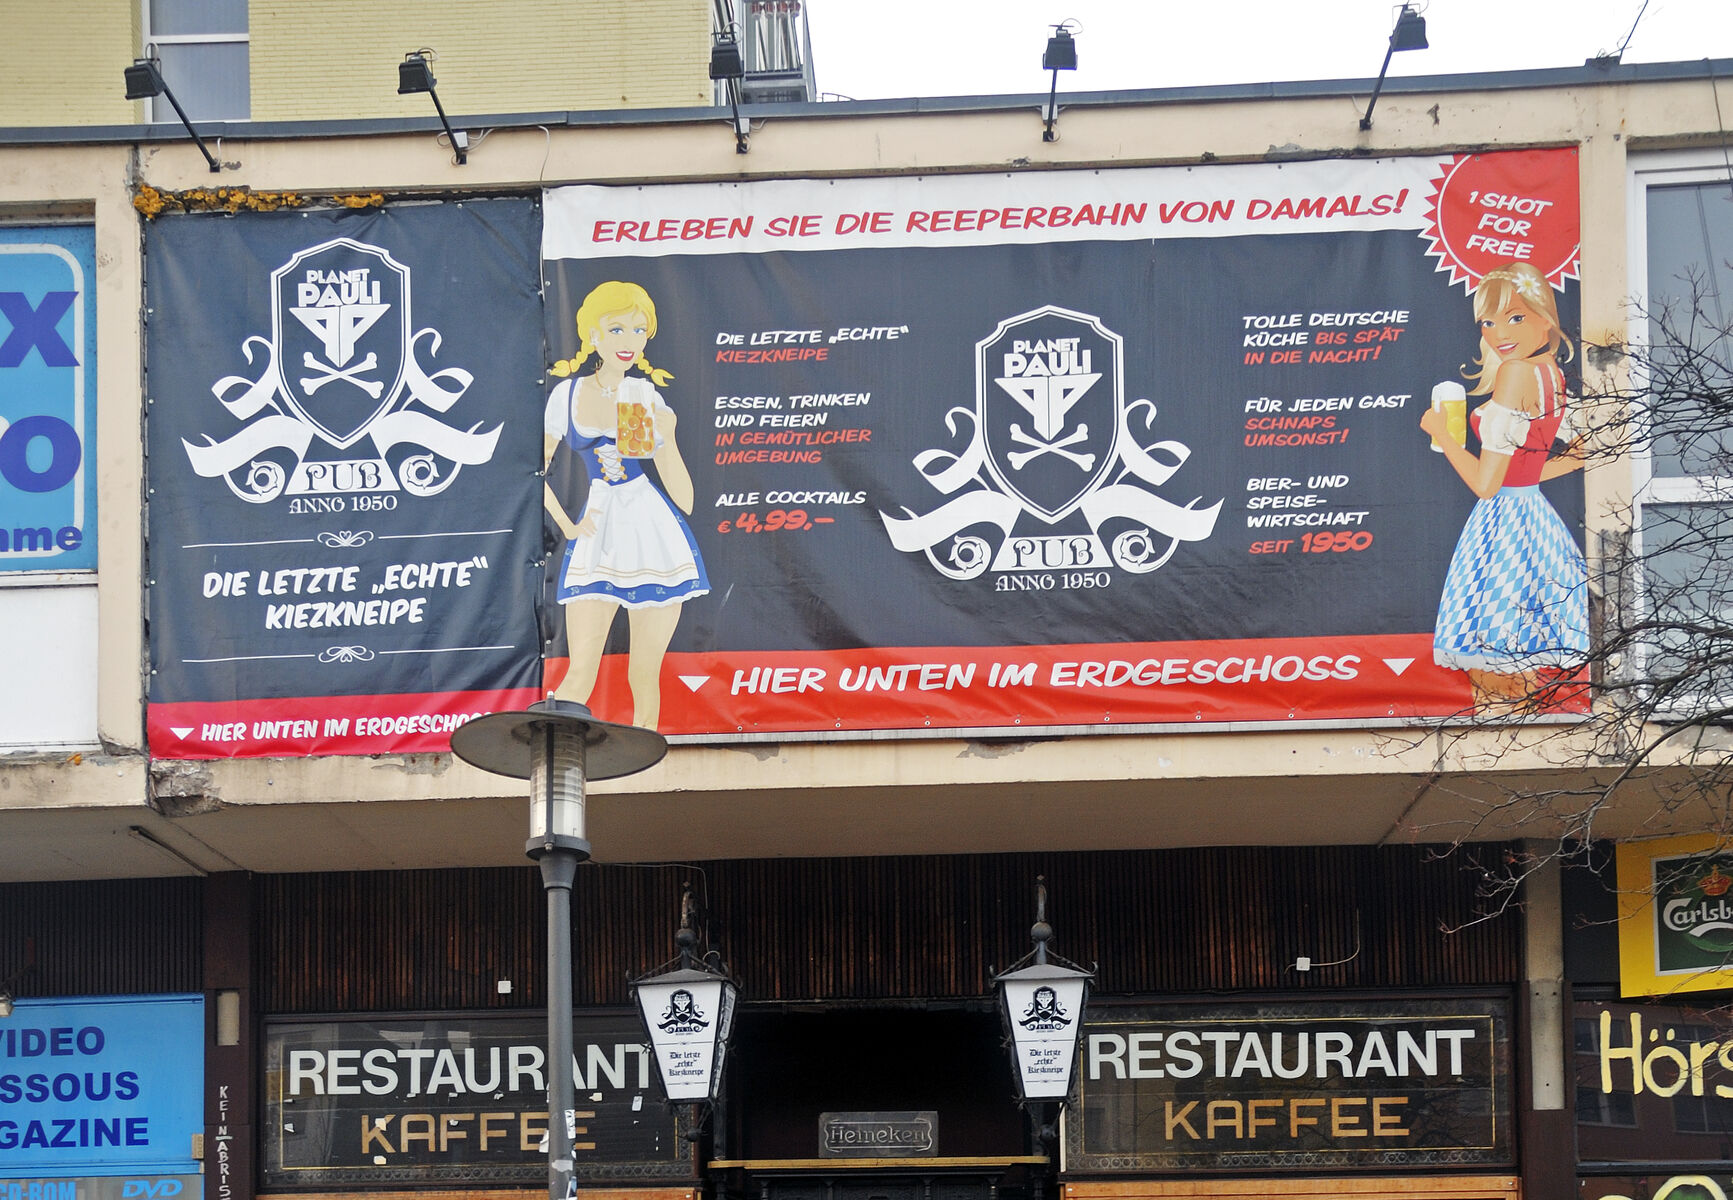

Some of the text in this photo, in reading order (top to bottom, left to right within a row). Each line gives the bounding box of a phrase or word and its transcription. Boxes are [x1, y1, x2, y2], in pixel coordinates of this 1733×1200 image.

[1480, 192, 1554, 217] SHOT
[591, 188, 1410, 243] ERLEBEN SIE DIE REEPERBAHN VON DAMALS!
[1477, 214, 1533, 238] FOR
[1465, 235, 1535, 261] FREE
[306, 268, 370, 285] PLANET
[298, 281, 380, 307] PAULI
[1243, 310, 1410, 329] TOLLE DEUTSCHE
[750, 330, 823, 346] LETZTE
[1013, 337, 1081, 355] PLANET
[1243, 326, 1405, 347] KÜCHE BIS SPÄT
[715, 348, 829, 364] KIEZKNEIPE
[1004, 350, 1092, 378] PAULI
[1244, 346, 1382, 365] IN DIE NACHT!
[789, 393, 871, 409] TRINKEN
[1245, 394, 1412, 413] FÜR JEDEN GAST
[715, 412, 828, 428] UND FEIERN
[1244, 415, 1337, 430] SCHNAPS
[715, 429, 872, 447] IN GEMÜTLICHER
[1244, 428, 1350, 447] UMSONST!
[715, 450, 822, 465] UMGEBUNG
[304, 461, 382, 491] PUB
[1246, 475, 1350, 491] BIER- UND
[289, 495, 398, 514] ANNO 1950
[715, 491, 867, 507] ALLE COCKTAILS
[1246, 494, 1327, 509] SPEISE-
[717, 520, 732, 534] €
[1246, 511, 1370, 528] WIRTSCHAFT
[1249, 530, 1374, 554] SEIT 1950
[1011, 539, 1095, 568] PUB
[203, 571, 248, 598] DIE
[257, 565, 361, 597] LETZTE
[995, 572, 1111, 592] ANNO 1950
[265, 597, 428, 630] KIEZKNEIPE
[730, 654, 1362, 696] HIER UNTEN IM ERDGESCHOSS
[201, 721, 246, 741] HIER
[253, 718, 320, 740] UNTEN
[323, 718, 349, 737] IM
[0, 1026, 106, 1058] IDEO
[1088, 1029, 1475, 1080] RESTAURANT
[1164, 1096, 1410, 1140] KAFFEE
[0, 1117, 149, 1150] GAZINE
[830, 1125, 927, 1144] Heineken
[122, 1179, 183, 1199] DVD
